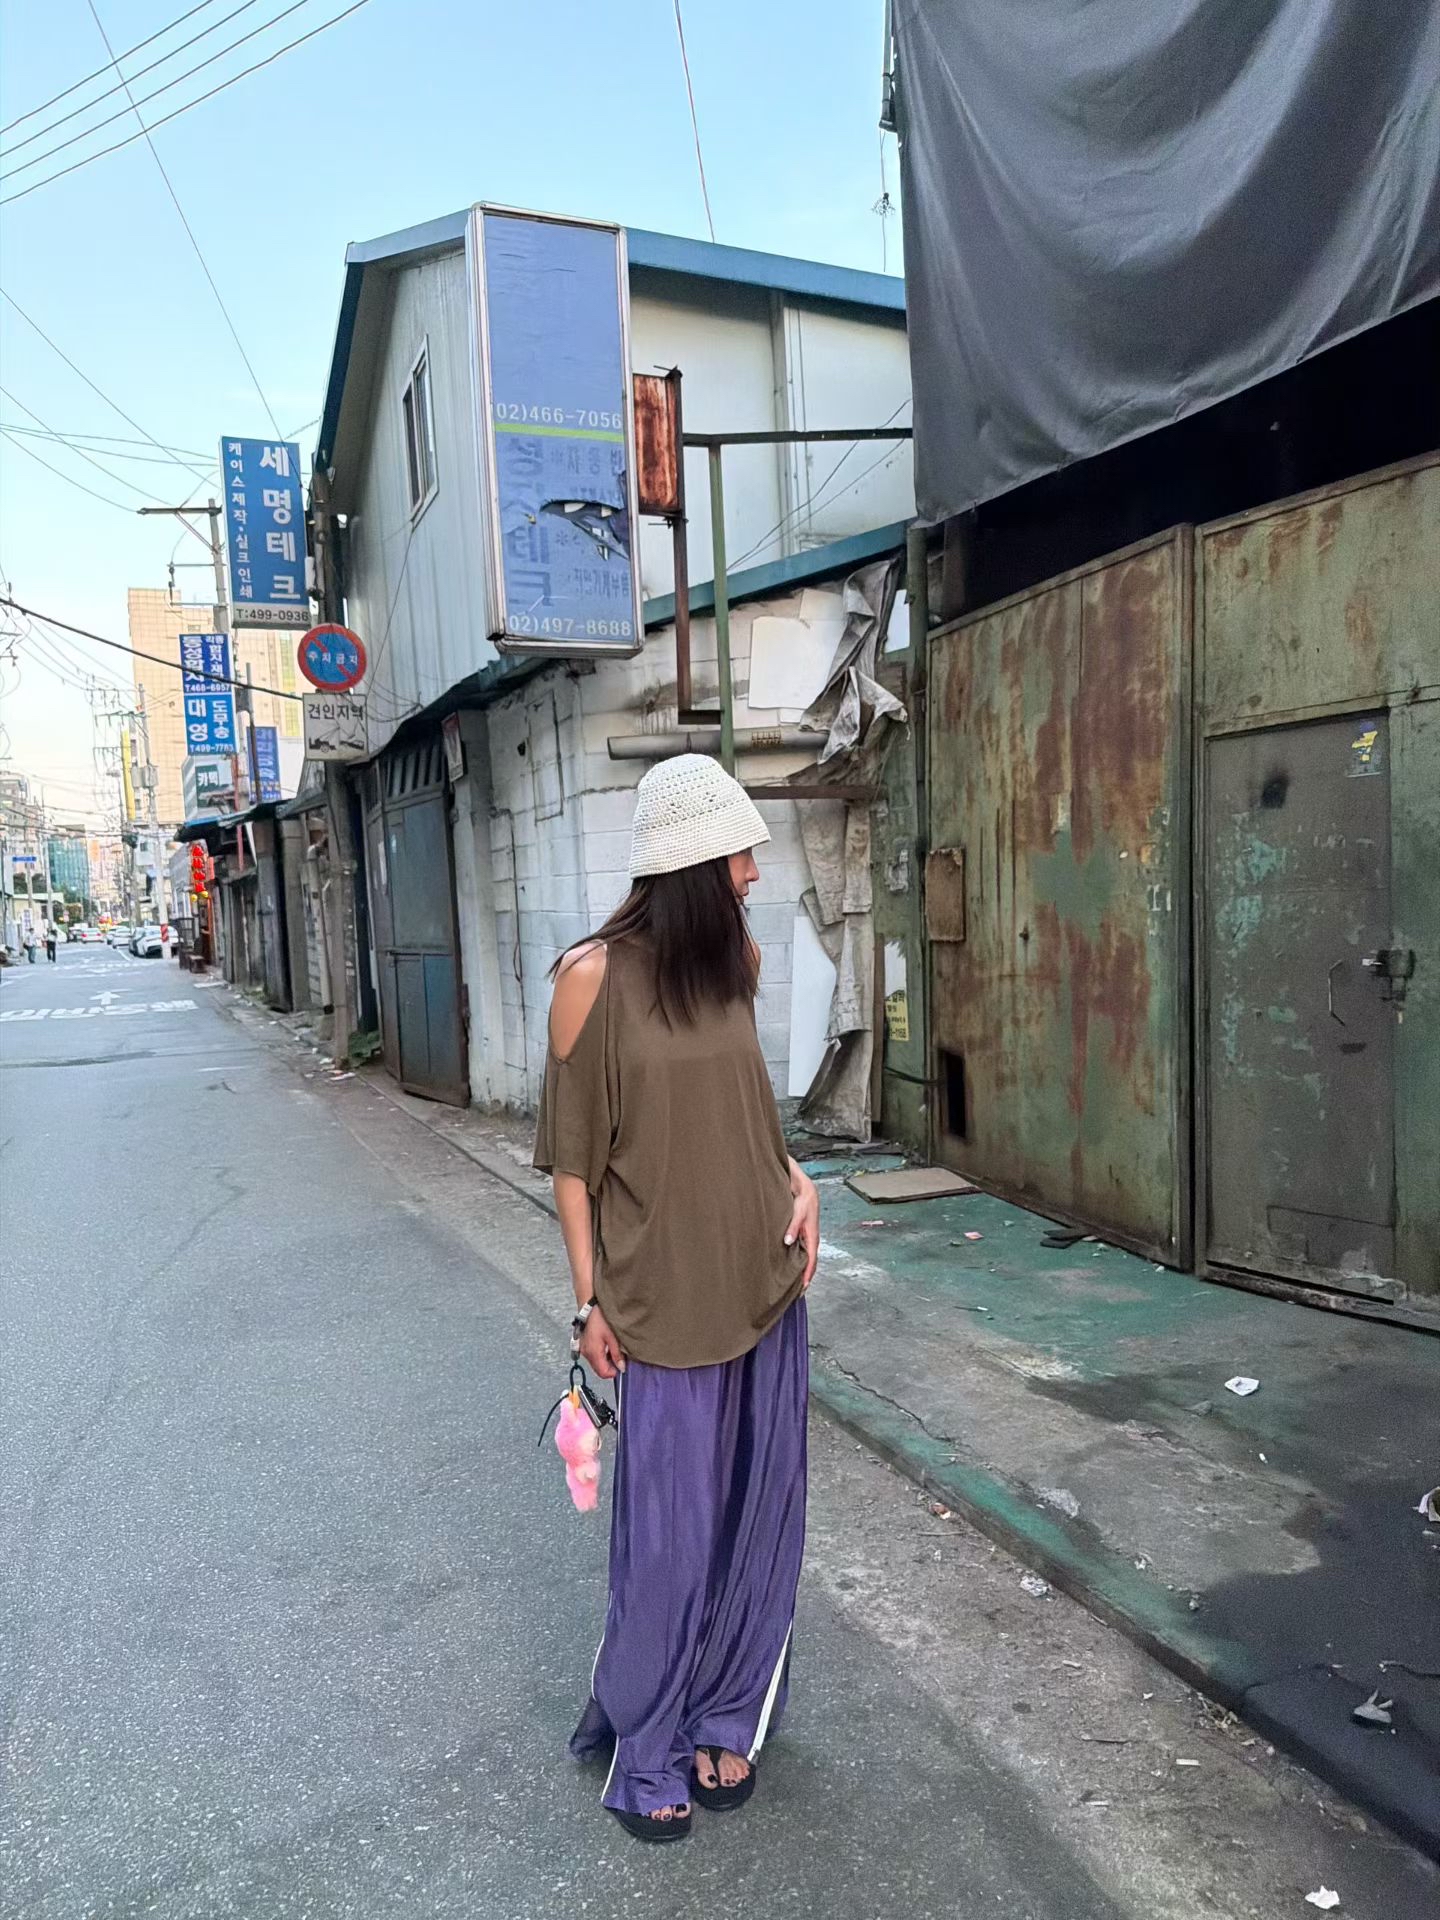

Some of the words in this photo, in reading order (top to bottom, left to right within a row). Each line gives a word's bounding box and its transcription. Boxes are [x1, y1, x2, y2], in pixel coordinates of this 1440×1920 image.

[497, 403, 622, 429] 02)466-7056
[259, 445, 301, 600] 세명테크
[236, 608, 309, 621] T:499-0936
[510, 615, 632, 637] 02)497-8688
[308, 650, 358, 665] 주차금지
[187, 698, 208, 742] 대영
[308, 703, 364, 720] 견인지역
